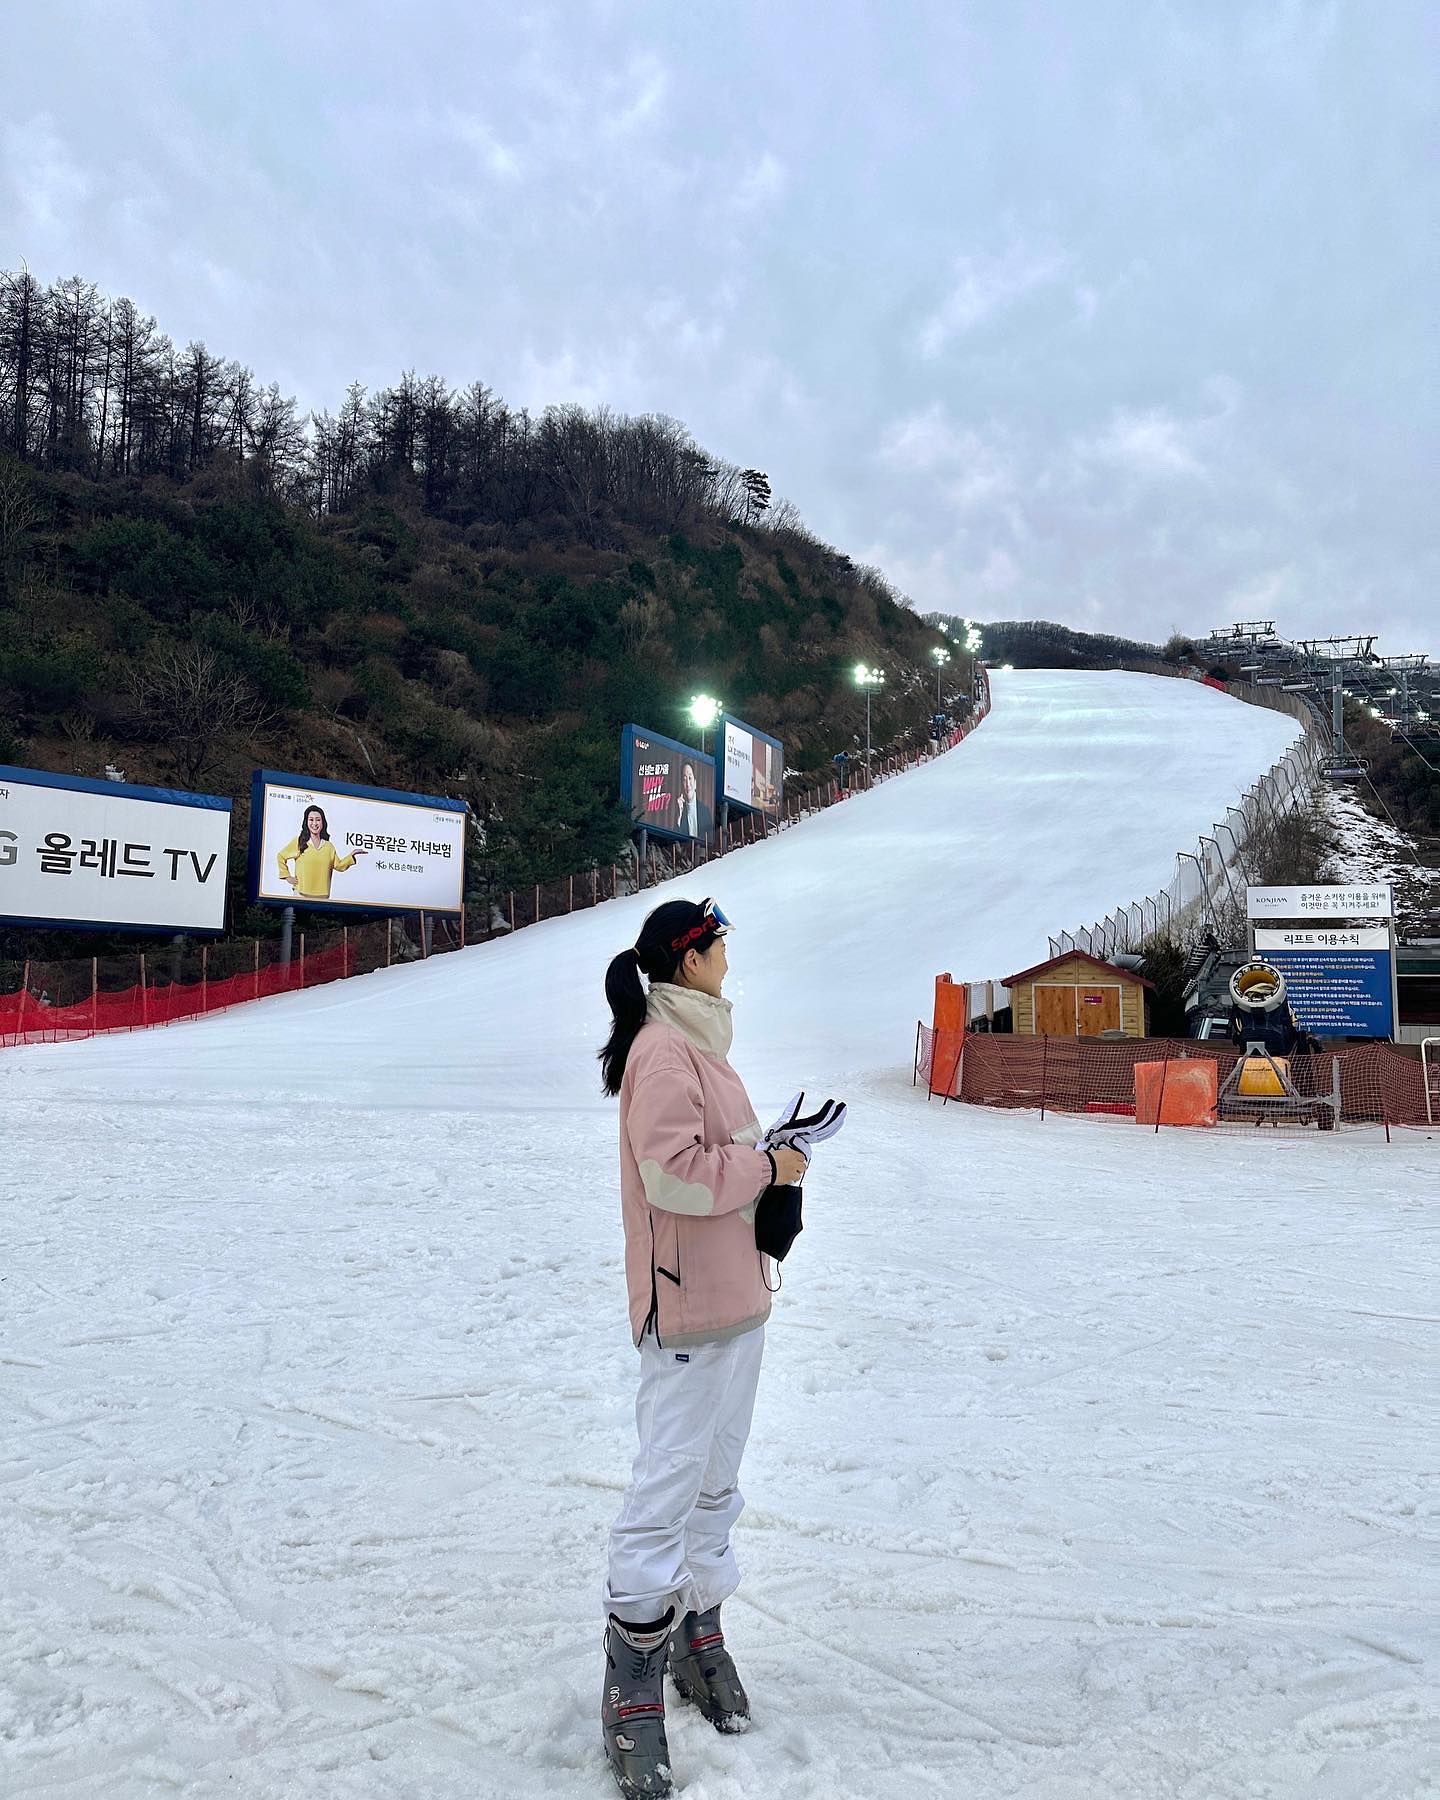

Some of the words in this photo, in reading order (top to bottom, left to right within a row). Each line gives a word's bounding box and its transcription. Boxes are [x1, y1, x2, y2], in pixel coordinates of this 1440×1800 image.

[643, 776, 665, 794] WHY
[648, 793, 672, 812] NOT?
[346, 832, 408, 853] KB금쪽같은
[410, 840, 452, 858] 자녀보험
[36, 832, 156, 878] 올레드
[162, 848, 218, 883] TV
[1300, 893, 1322, 902] 즐거운
[1324, 893, 1346, 901] 스키장
[1348, 892, 1369, 901] 이용을
[1371, 892, 1386, 900] 위해
[1300, 902, 1329, 910] 이것만은
[1341, 901, 1380, 909] 지켜주세요!
[1284, 934, 1315, 945] 리프트
[1317, 934, 1360, 946] 이용수칙
